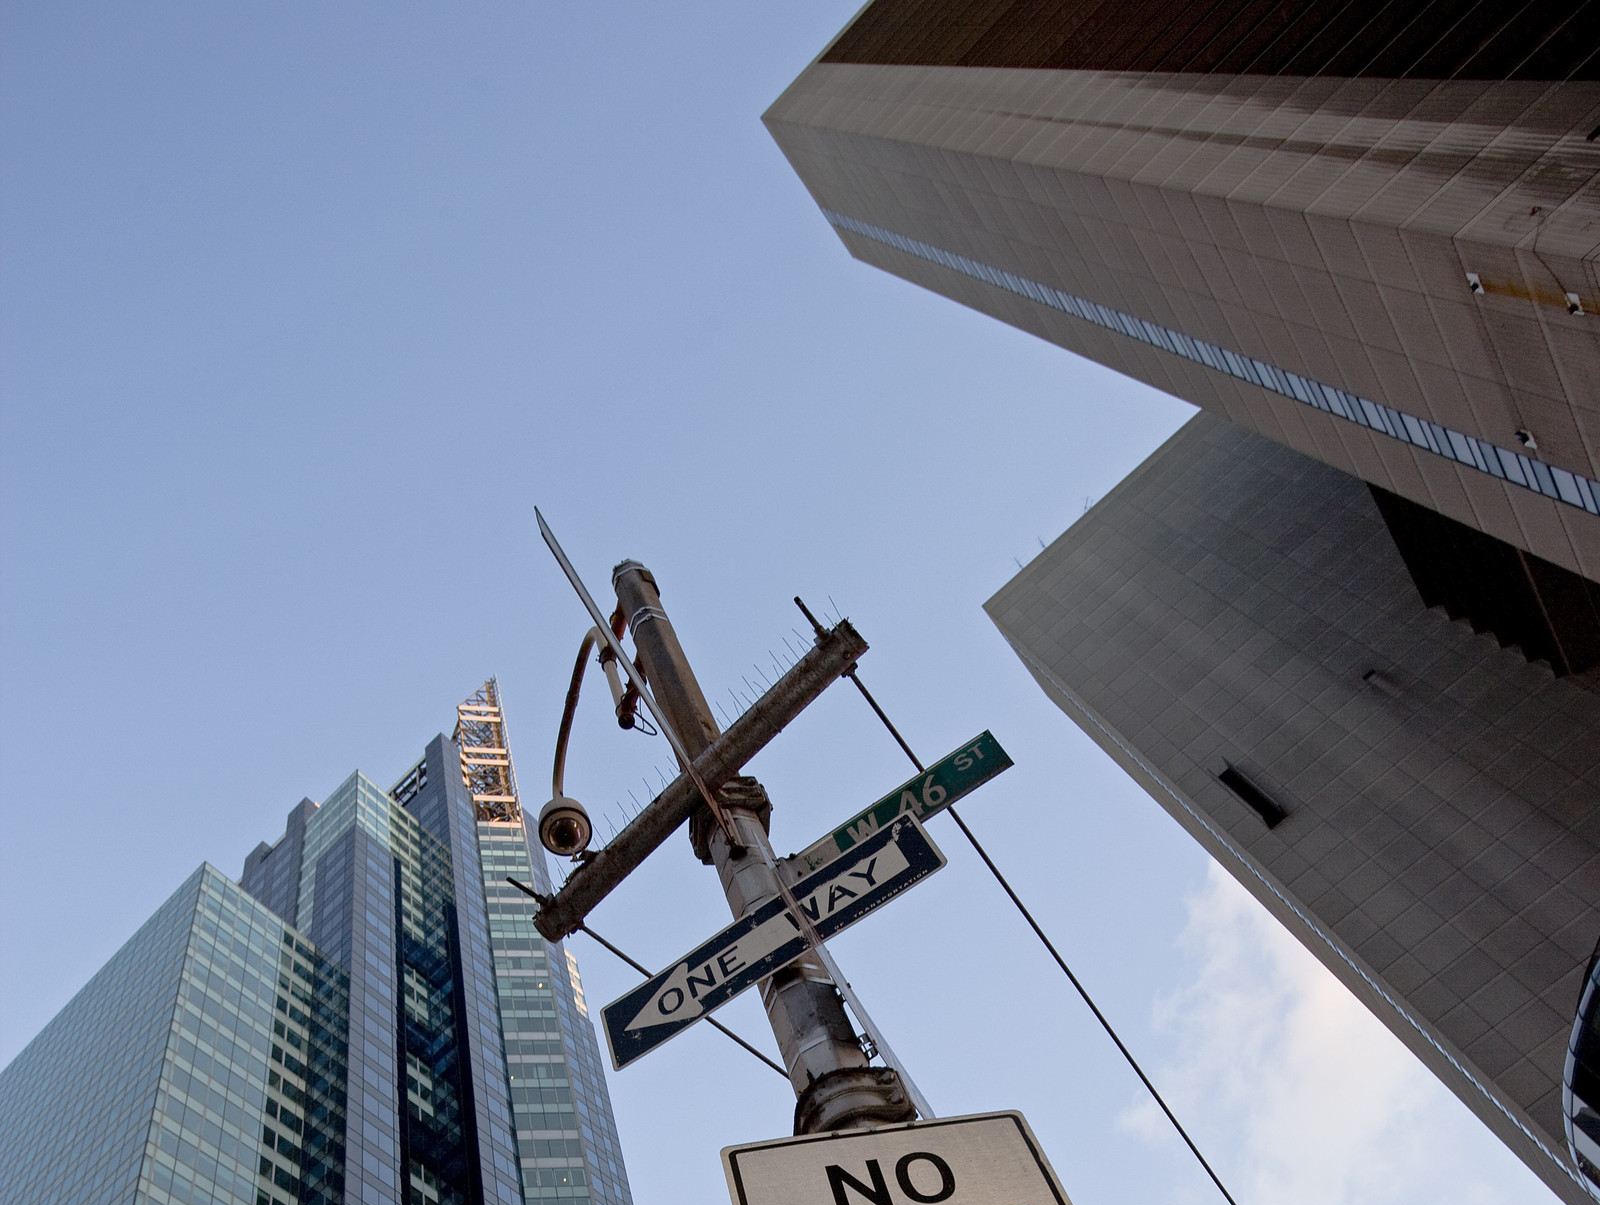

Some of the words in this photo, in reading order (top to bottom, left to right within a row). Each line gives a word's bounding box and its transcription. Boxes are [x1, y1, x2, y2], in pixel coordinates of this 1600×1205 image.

[846, 811, 879, 843] W
[899, 774, 947, 817] 46
[953, 742, 985, 771] ST
[658, 945, 747, 1016] ONE
[784, 854, 880, 932] WAY
[853, 868, 928, 919] TRANSPORTATION
